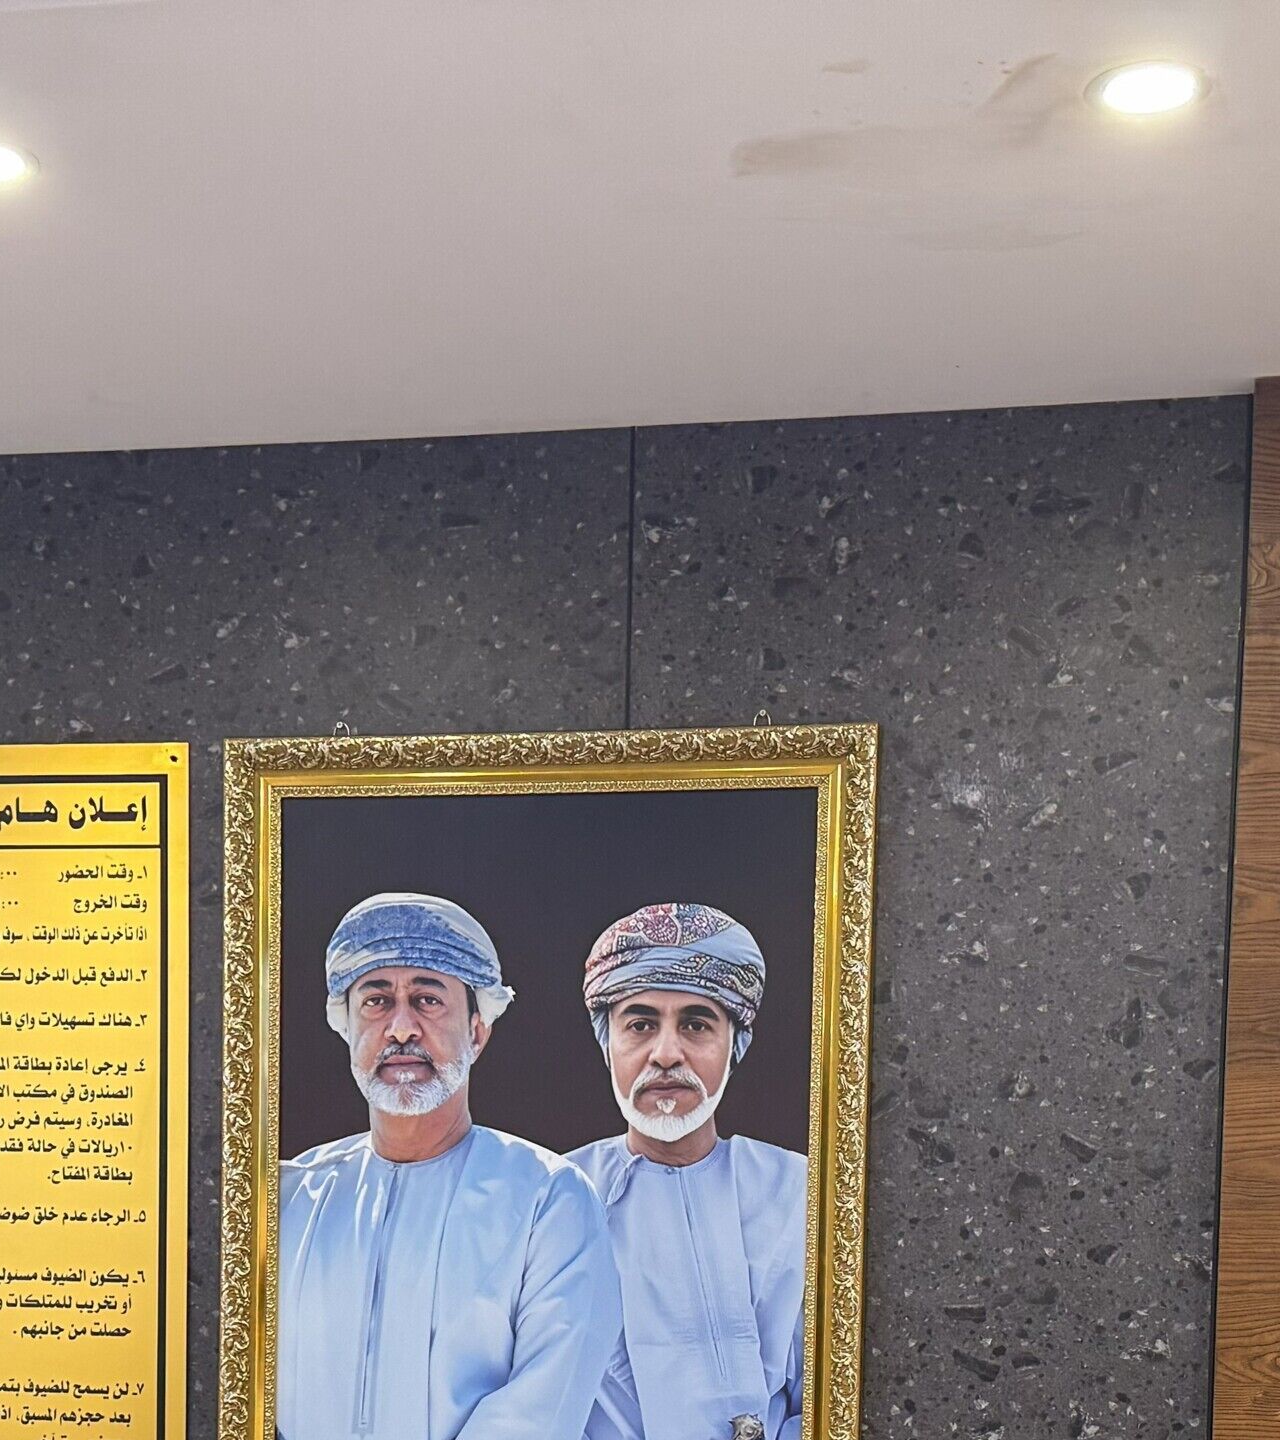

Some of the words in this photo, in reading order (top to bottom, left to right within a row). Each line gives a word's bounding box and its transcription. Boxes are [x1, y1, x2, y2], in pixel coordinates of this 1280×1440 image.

[57, 864, 104, 883] الحضور
[106, 863, 134, 883] وقت
[73, 893, 118, 914] الخروج
[121, 893, 148, 914] وقت
[14, 1012, 36, 1032] واي
[38, 1011, 96, 1031] تسهيلات
[98, 1012, 133, 1027] هناك
[12, 1083, 58, 1103] مكتب
[60, 1082, 76, 1105] في
[78, 1084, 134, 1103] الصندوق
[47, 1165, 91, 1185] المفتاح.
[92, 1165, 133, 1186] بطاقة
